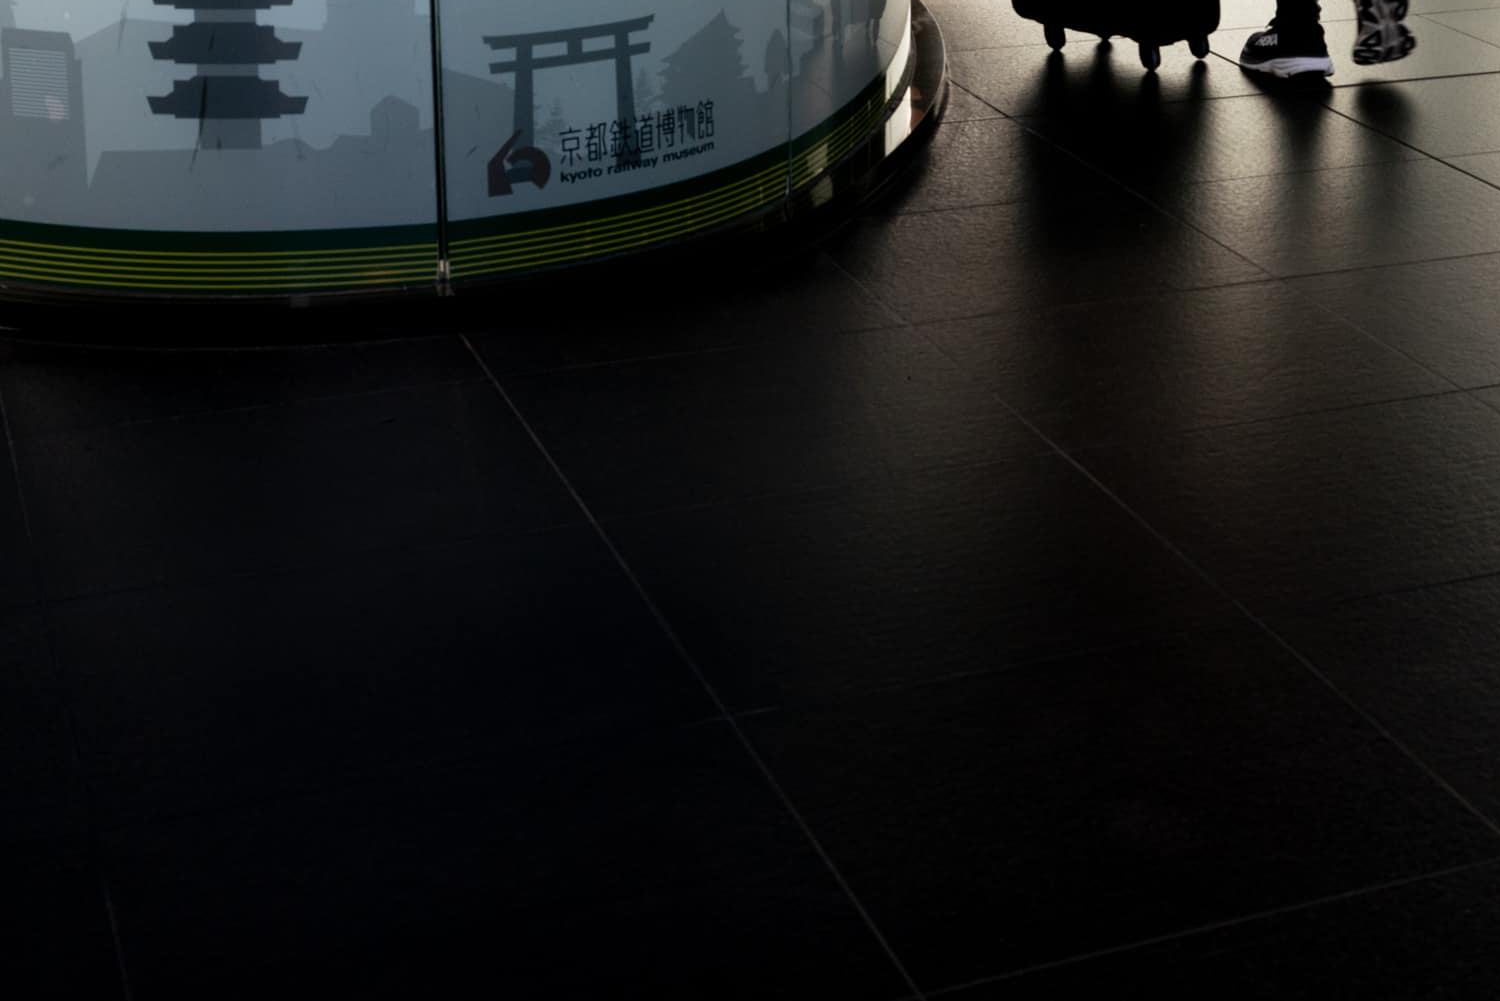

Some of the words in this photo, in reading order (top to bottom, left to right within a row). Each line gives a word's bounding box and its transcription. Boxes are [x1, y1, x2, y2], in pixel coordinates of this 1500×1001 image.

[560, 99, 714, 167] 京都鉄道博物館
[560, 167, 602, 184] kyoto
[607, 156, 658, 174] railway
[663, 141, 714, 162] museum
